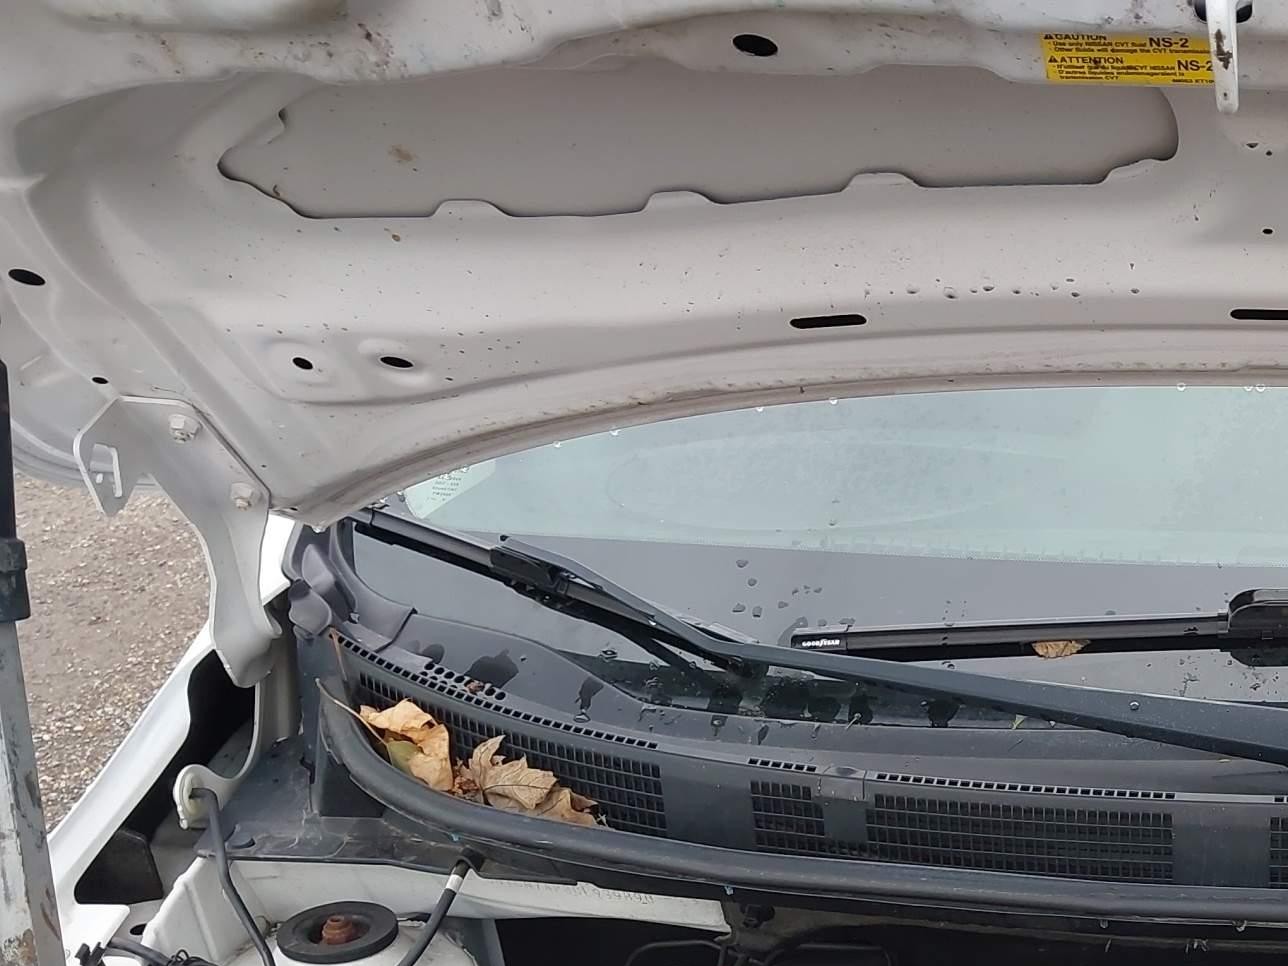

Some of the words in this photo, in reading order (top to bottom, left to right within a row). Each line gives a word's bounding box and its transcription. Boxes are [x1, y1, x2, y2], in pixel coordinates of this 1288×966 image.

[1149, 37, 1189, 47] NS-2
[1177, 60, 1213, 71] NS-2
[802, 638, 840, 647] GOODYEAR
